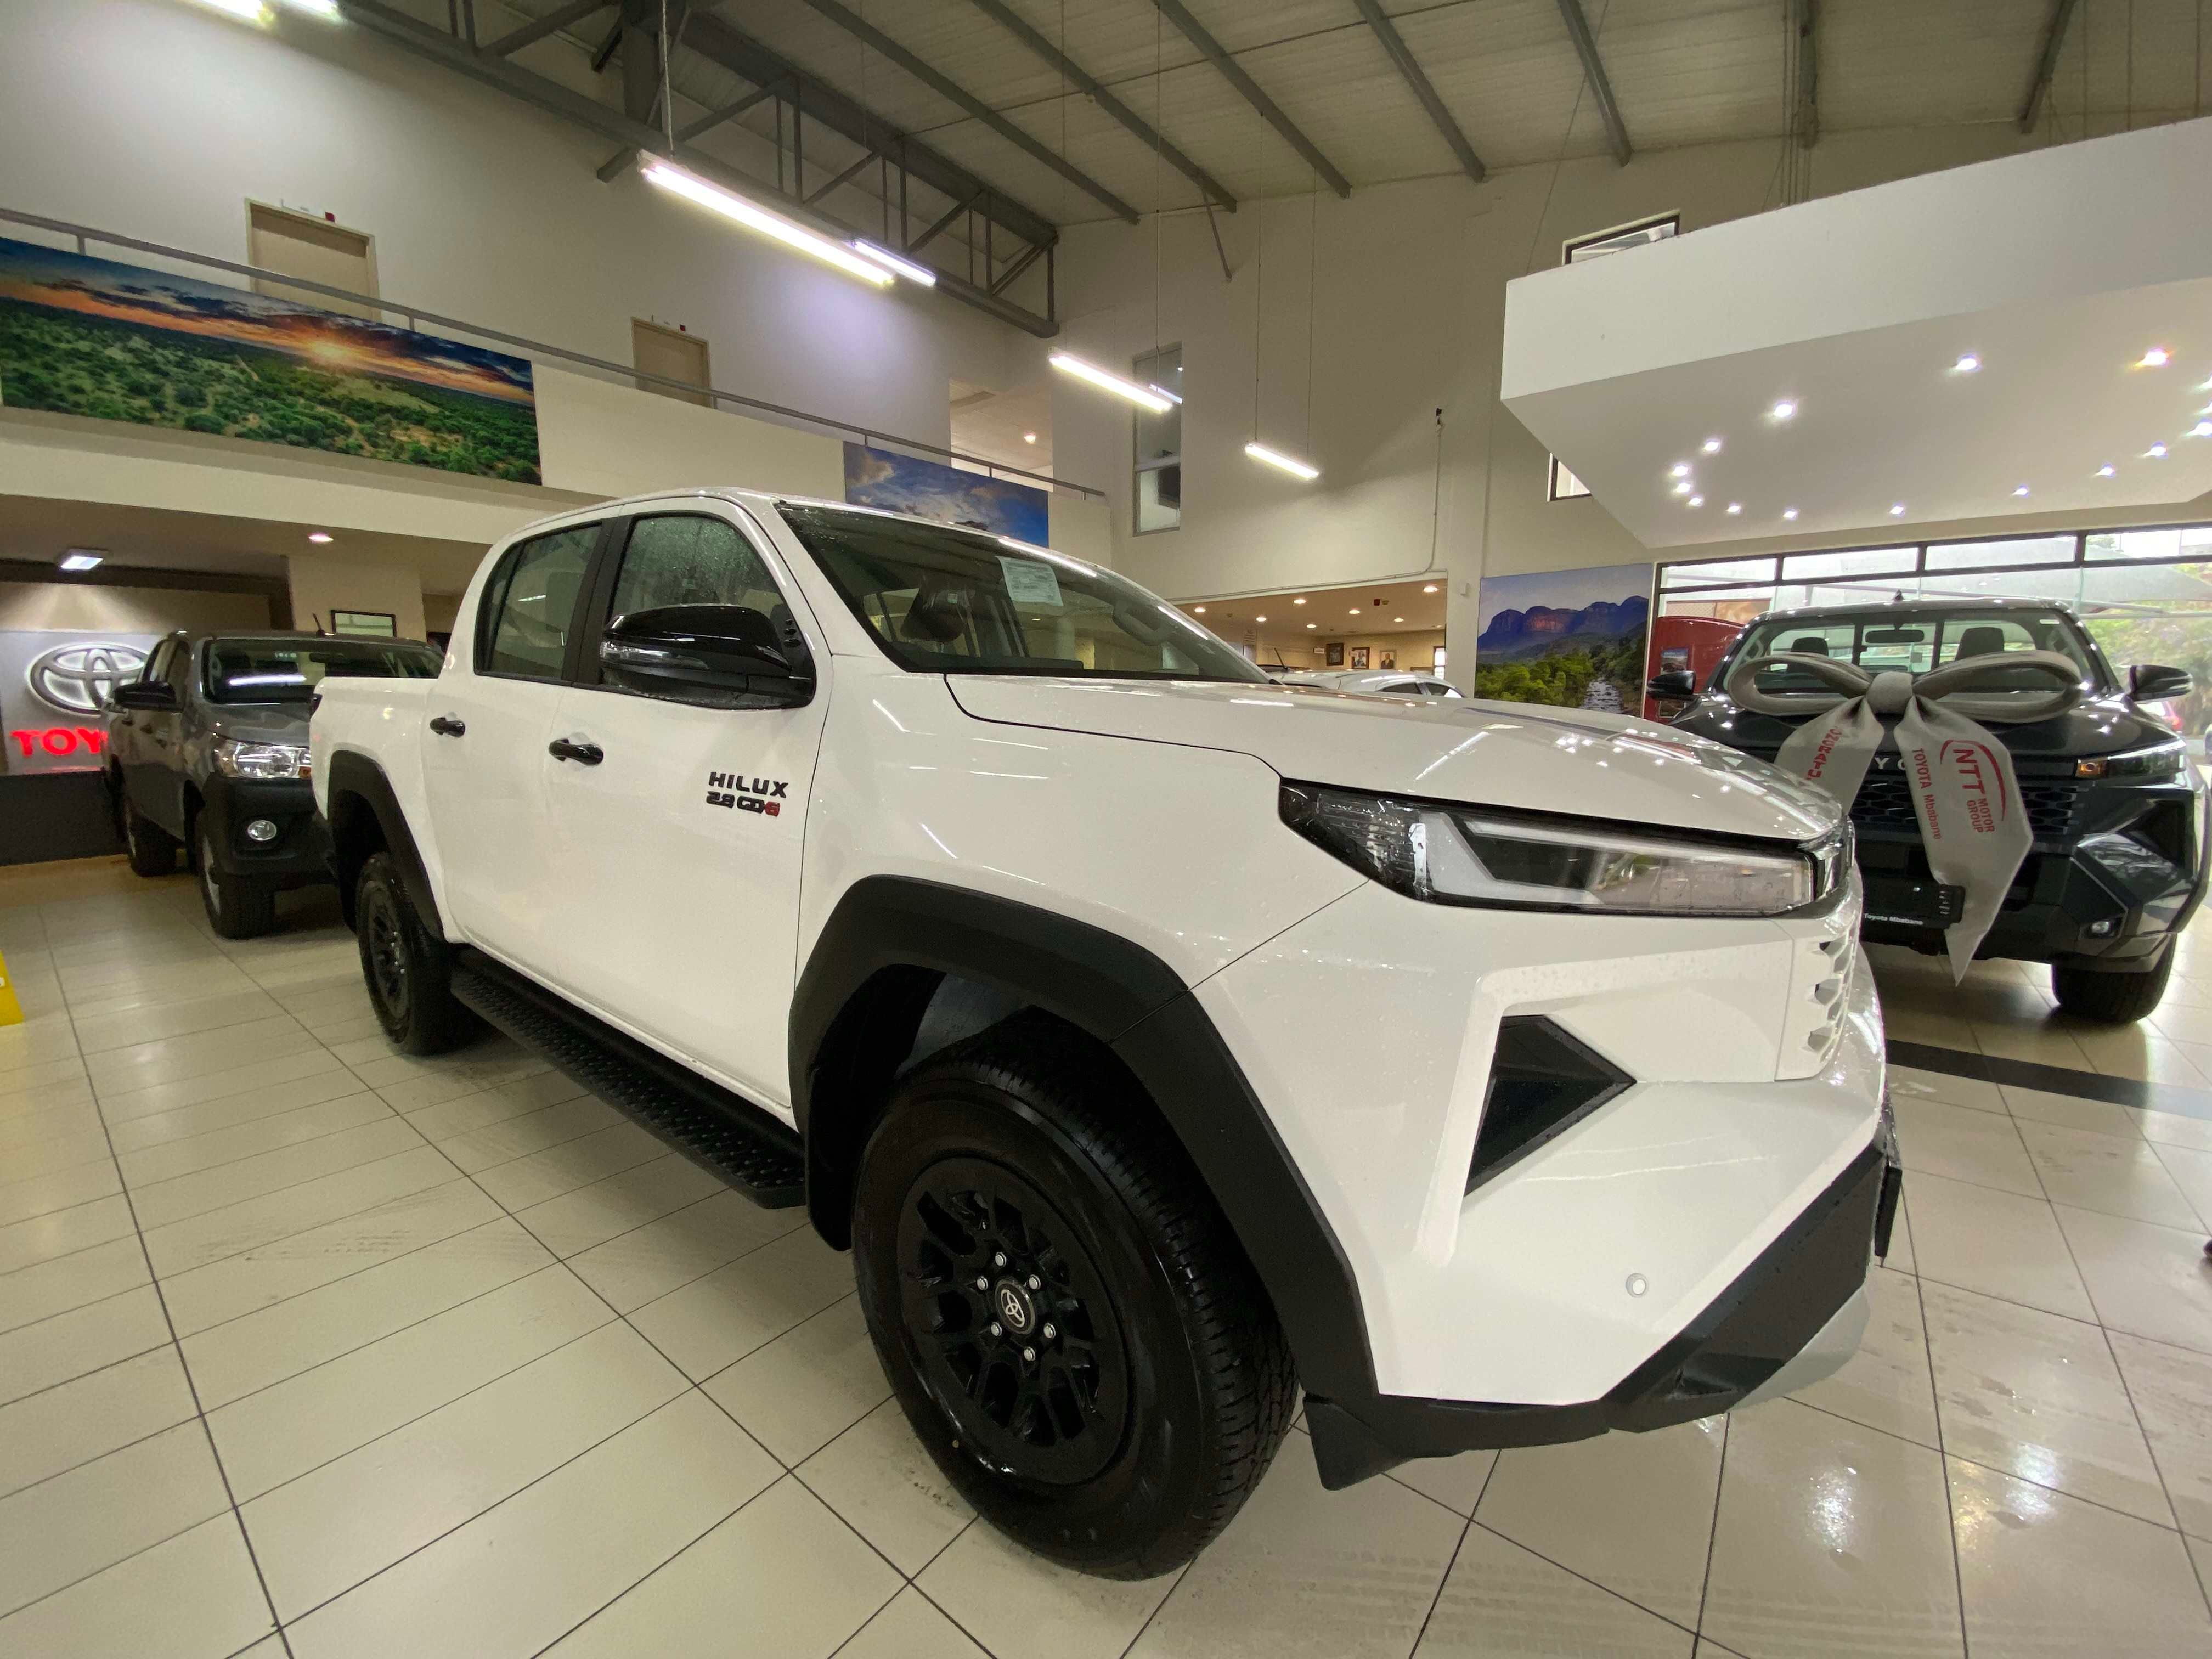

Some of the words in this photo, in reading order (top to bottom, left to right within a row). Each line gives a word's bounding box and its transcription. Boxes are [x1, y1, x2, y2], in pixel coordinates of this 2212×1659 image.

[709, 772, 788, 798] HILUX
[1953, 749, 1985, 794] NTT
[1912, 748, 1932, 789] TOYOTA
[1924, 794, 1942, 839] Mbabane
[1967, 800, 1983, 833] GROUP
[1978, 798, 1995, 832] MOTOR
[1864, 913, 1888, 922] Toyota
